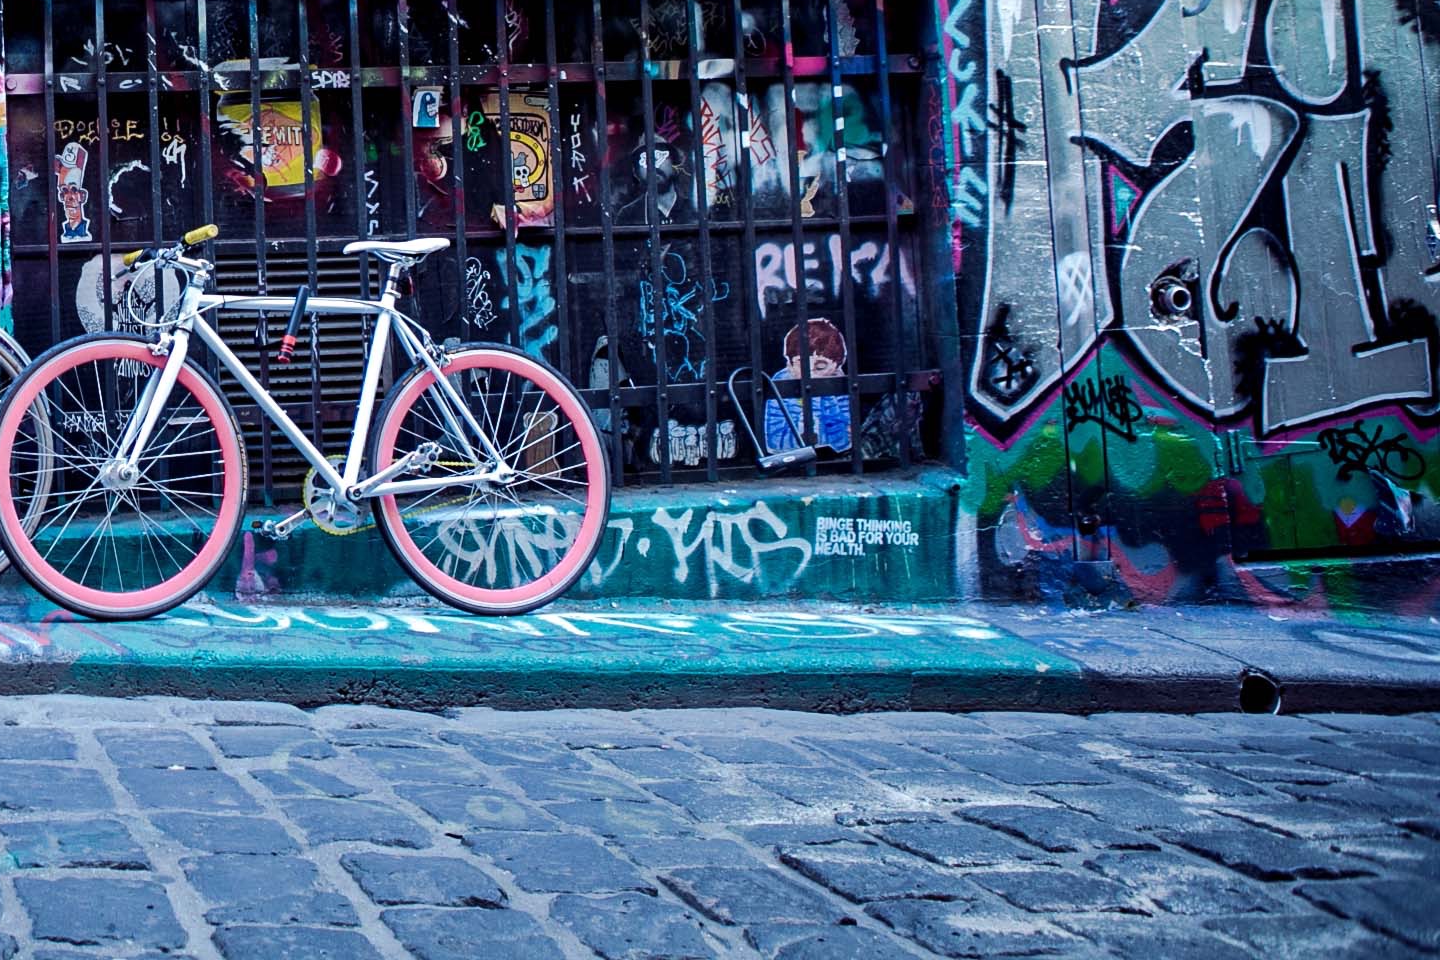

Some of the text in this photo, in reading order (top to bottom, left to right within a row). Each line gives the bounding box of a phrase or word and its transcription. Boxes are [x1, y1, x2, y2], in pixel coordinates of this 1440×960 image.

[816, 516, 912, 533] BINGE THINKING
[816, 530, 919, 546] IS BAD FOR YOUR
[814, 542, 866, 556] HEALTH.
